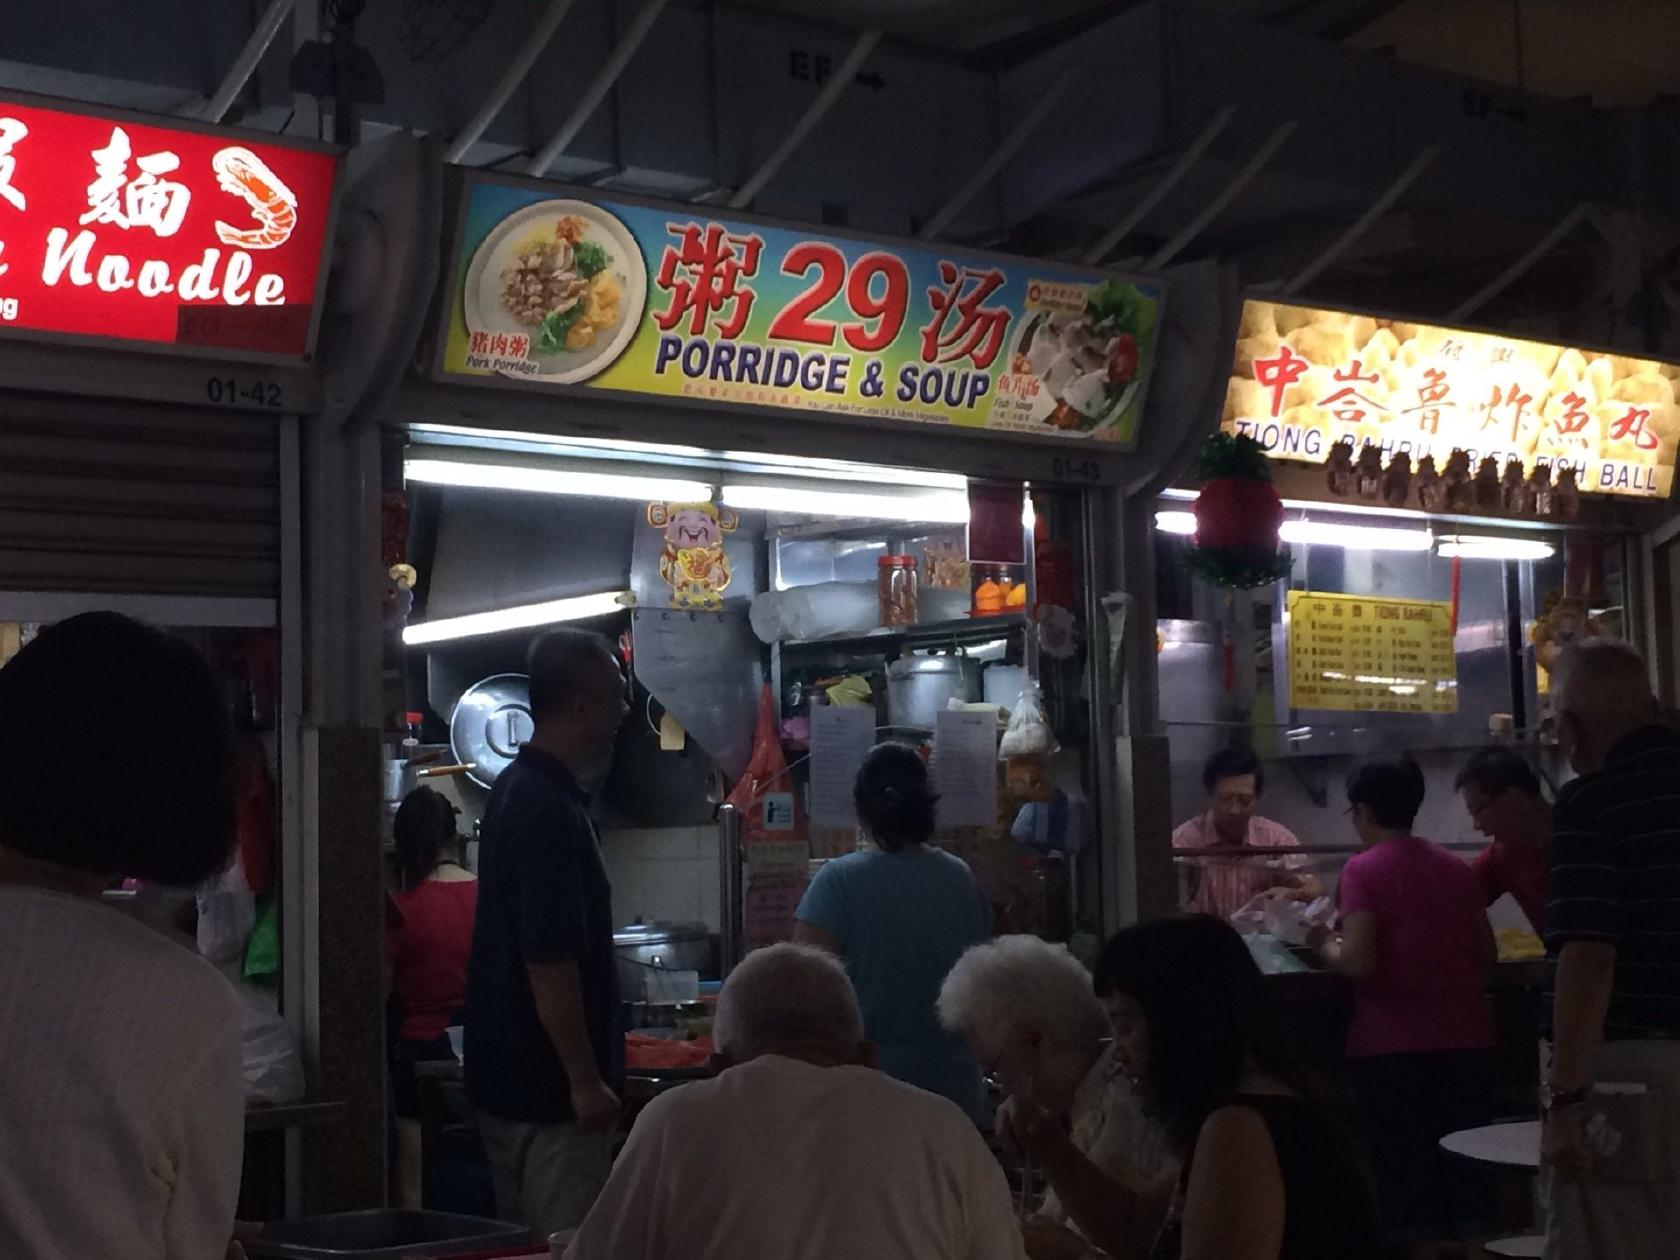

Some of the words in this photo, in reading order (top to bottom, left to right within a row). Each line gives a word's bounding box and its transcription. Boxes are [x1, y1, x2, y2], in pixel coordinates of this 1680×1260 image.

[42, 227, 285, 305] Noodle
[654, 222, 766, 339] 粥
[768, 241, 911, 352] 29
[921, 261, 1013, 370] 汤
[207, 377, 283, 407] 01-42
[466, 355, 490, 369] Pork
[493, 358, 538, 376] Porridge
[655, 335, 850, 393] PORRIDGE
[859, 361, 884, 399] &
[896, 365, 990, 410] SOUP
[1236, 421, 1320, 455] TIONG
[1600, 463, 1657, 491] BALL
